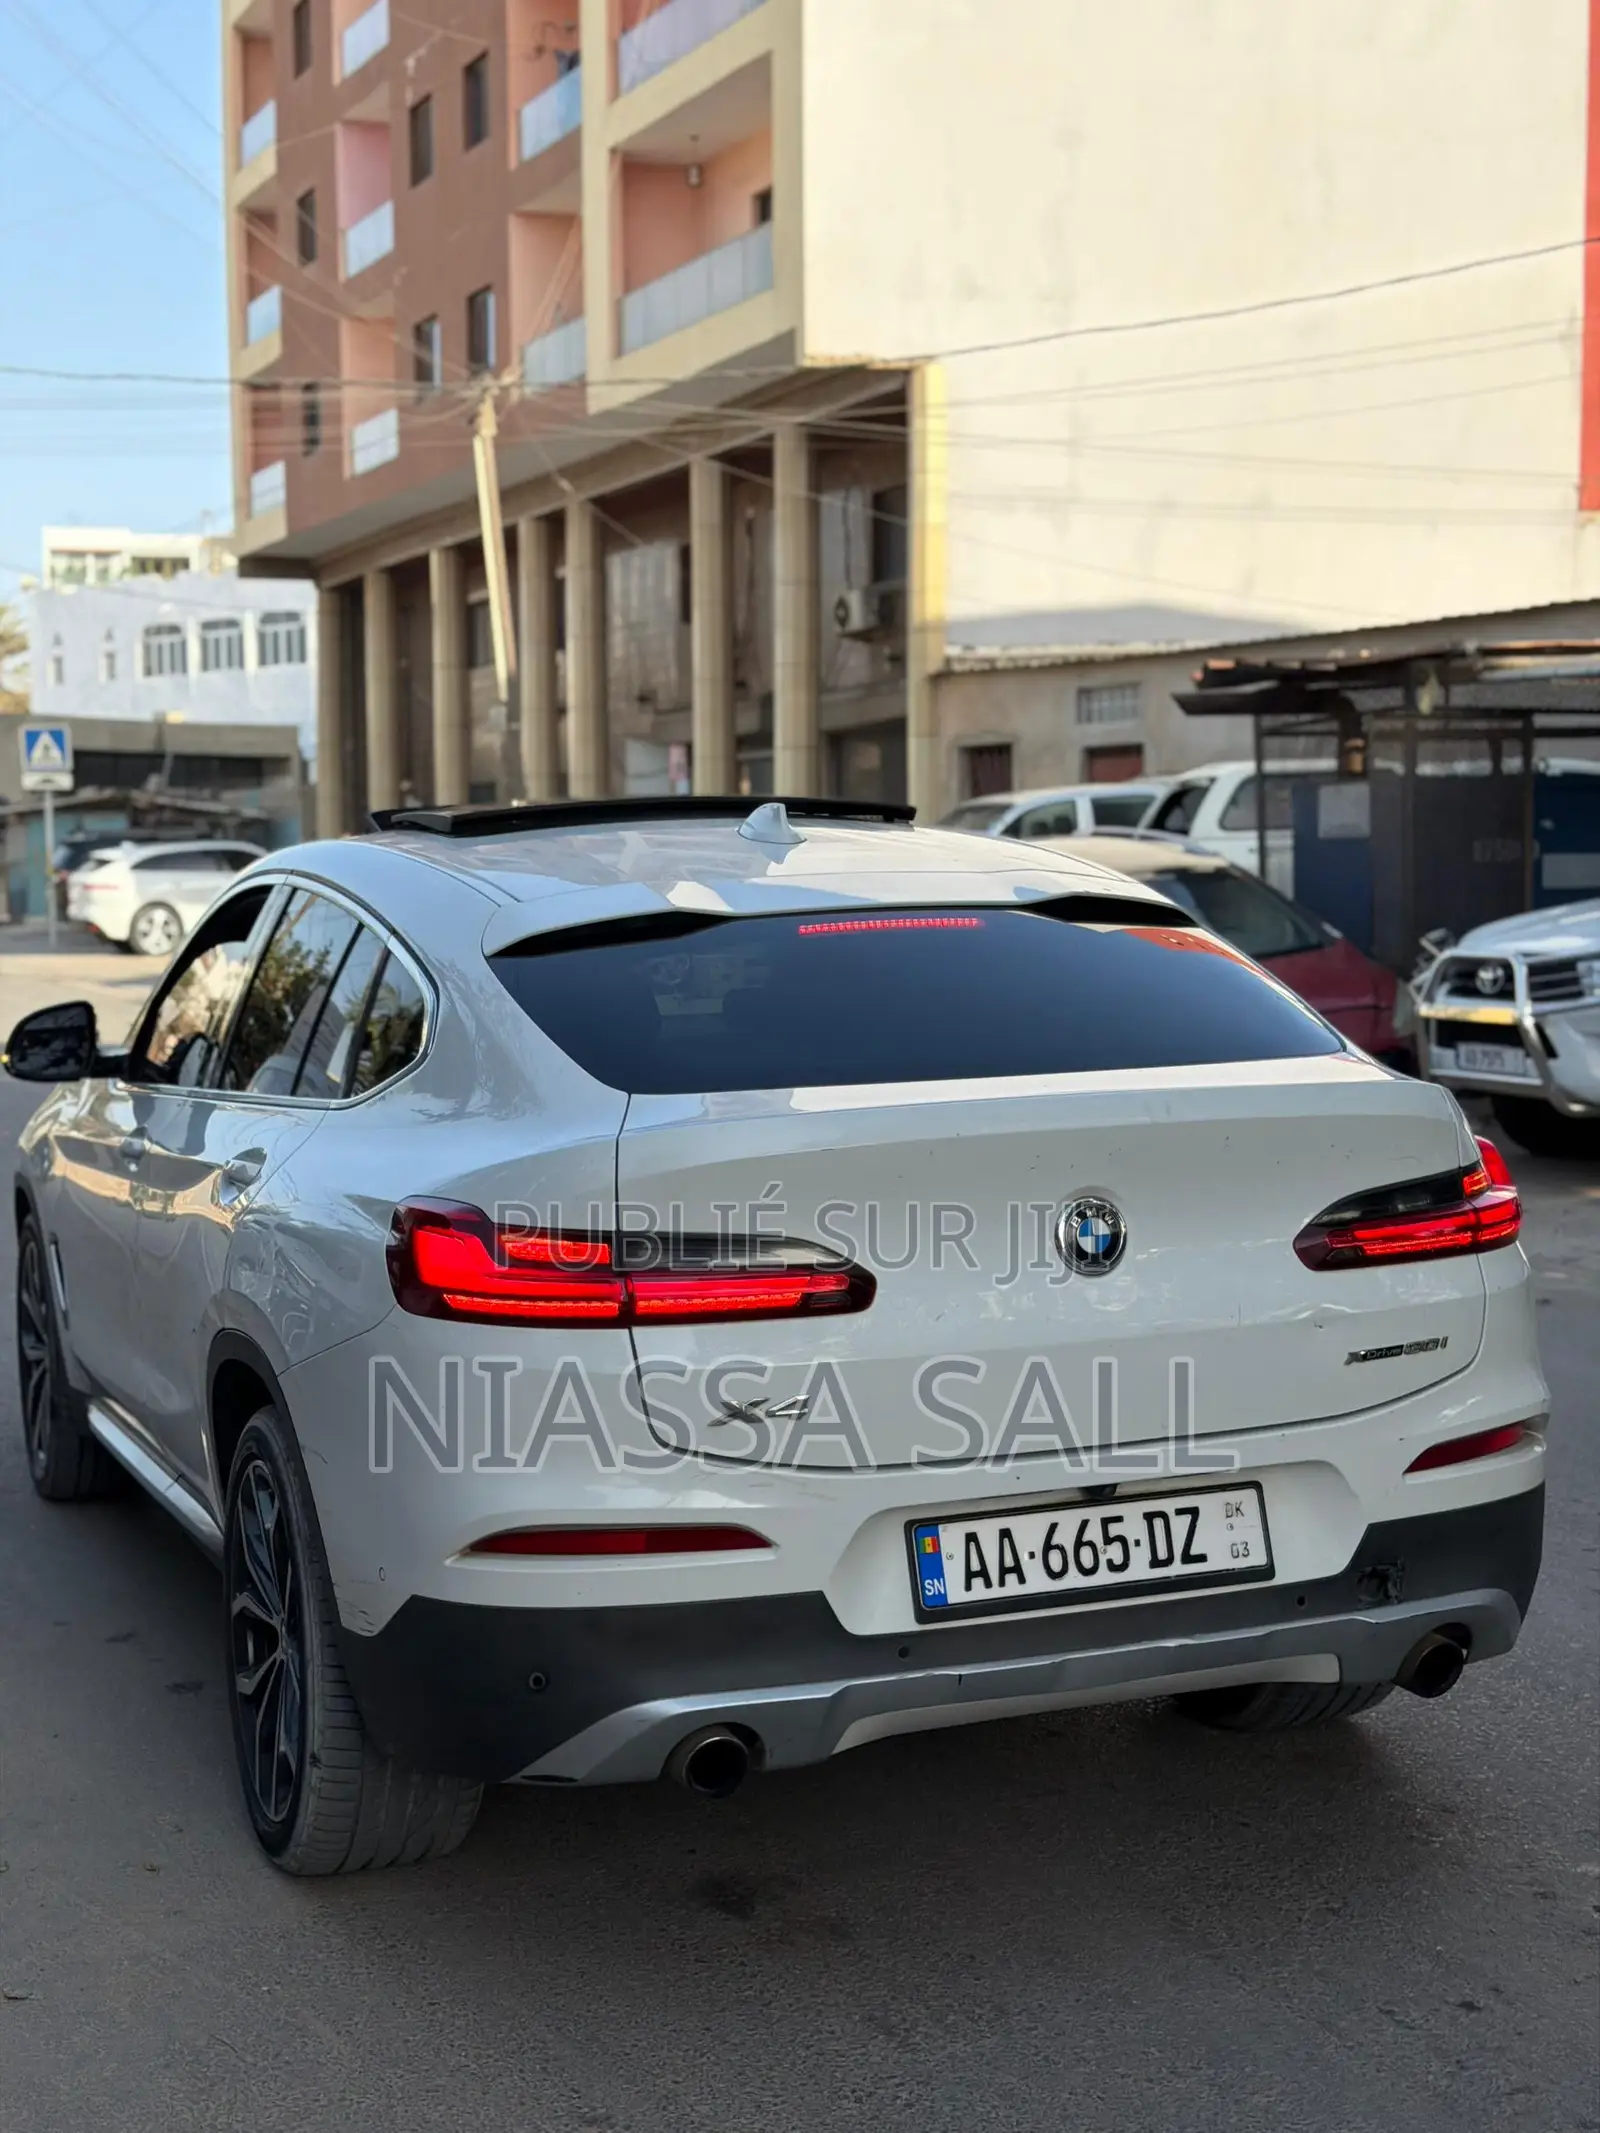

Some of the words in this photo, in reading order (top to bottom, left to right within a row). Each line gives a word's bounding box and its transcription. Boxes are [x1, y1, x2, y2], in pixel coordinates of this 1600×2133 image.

[1071, 1207, 1114, 1228] BMW
[707, 1395, 810, 1426] X4
[1224, 1501, 1245, 1519] DK
[925, 1579, 945, 1596] SN
